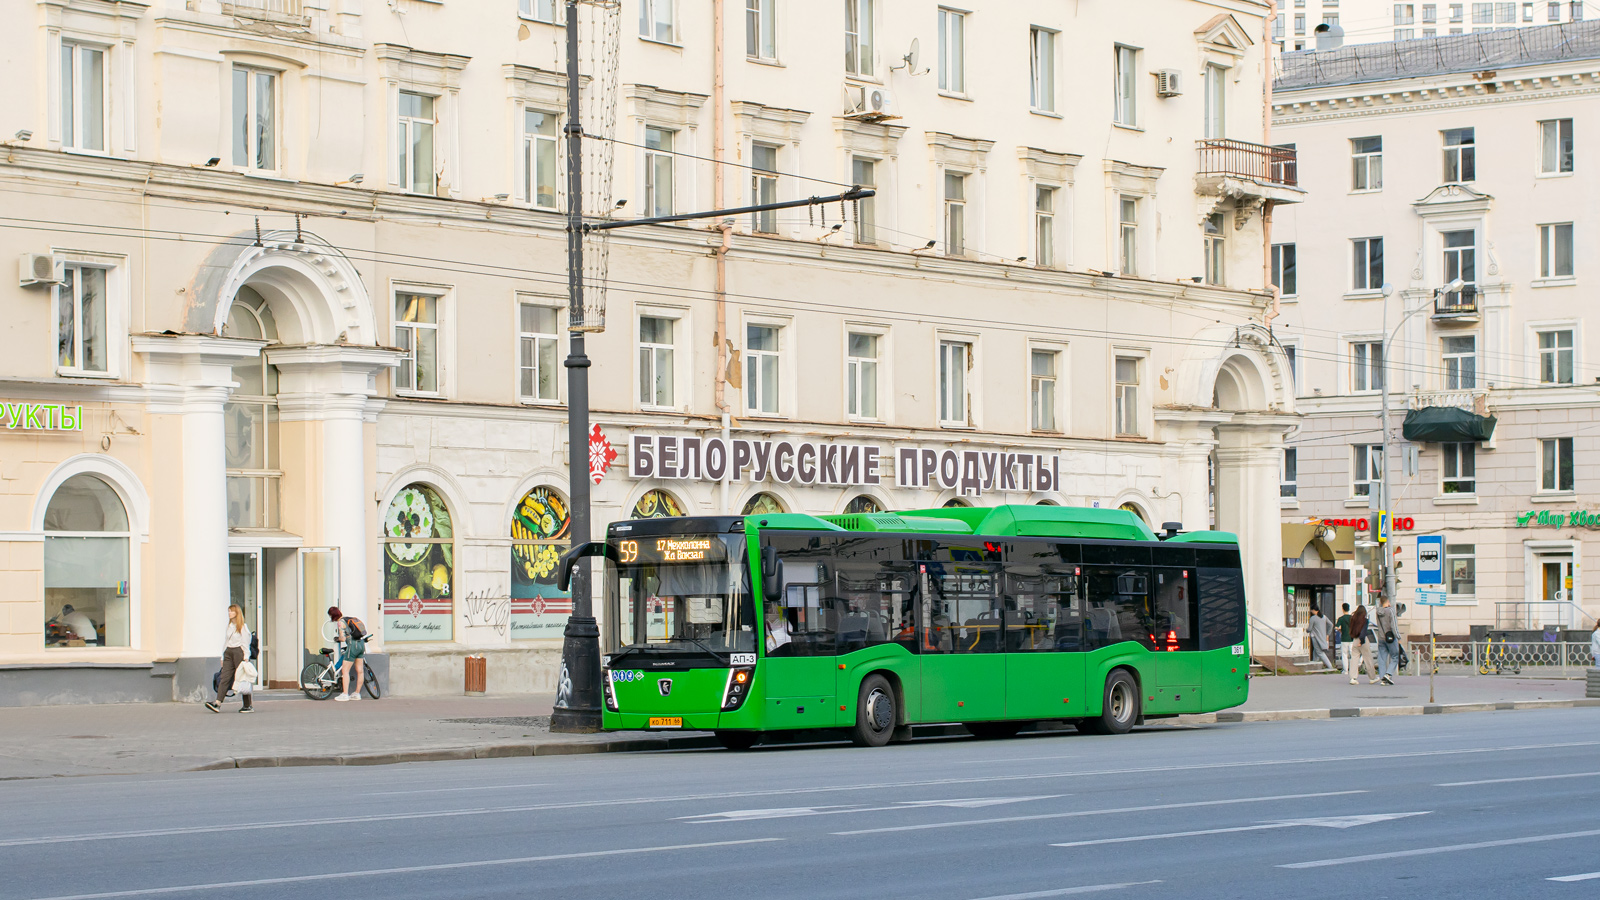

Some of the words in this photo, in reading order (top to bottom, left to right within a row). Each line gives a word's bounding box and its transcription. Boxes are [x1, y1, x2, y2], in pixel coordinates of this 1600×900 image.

[630, 434, 880, 484] БЕЛОРУССКИЕ
[896, 447, 1060, 497] ПРОДУКТЫ
[1323, 517, 1415, 531] ЕРМОНО
[1537, 510, 1565, 530] Мир
[656, 540, 666, 551] 17
[620, 541, 638, 562] 59
[677, 550, 704, 560] Вокзал
[1233, 646, 1242, 654] 361
[732, 654, 755, 664] АП-3
[661, 718, 672, 726] 711
